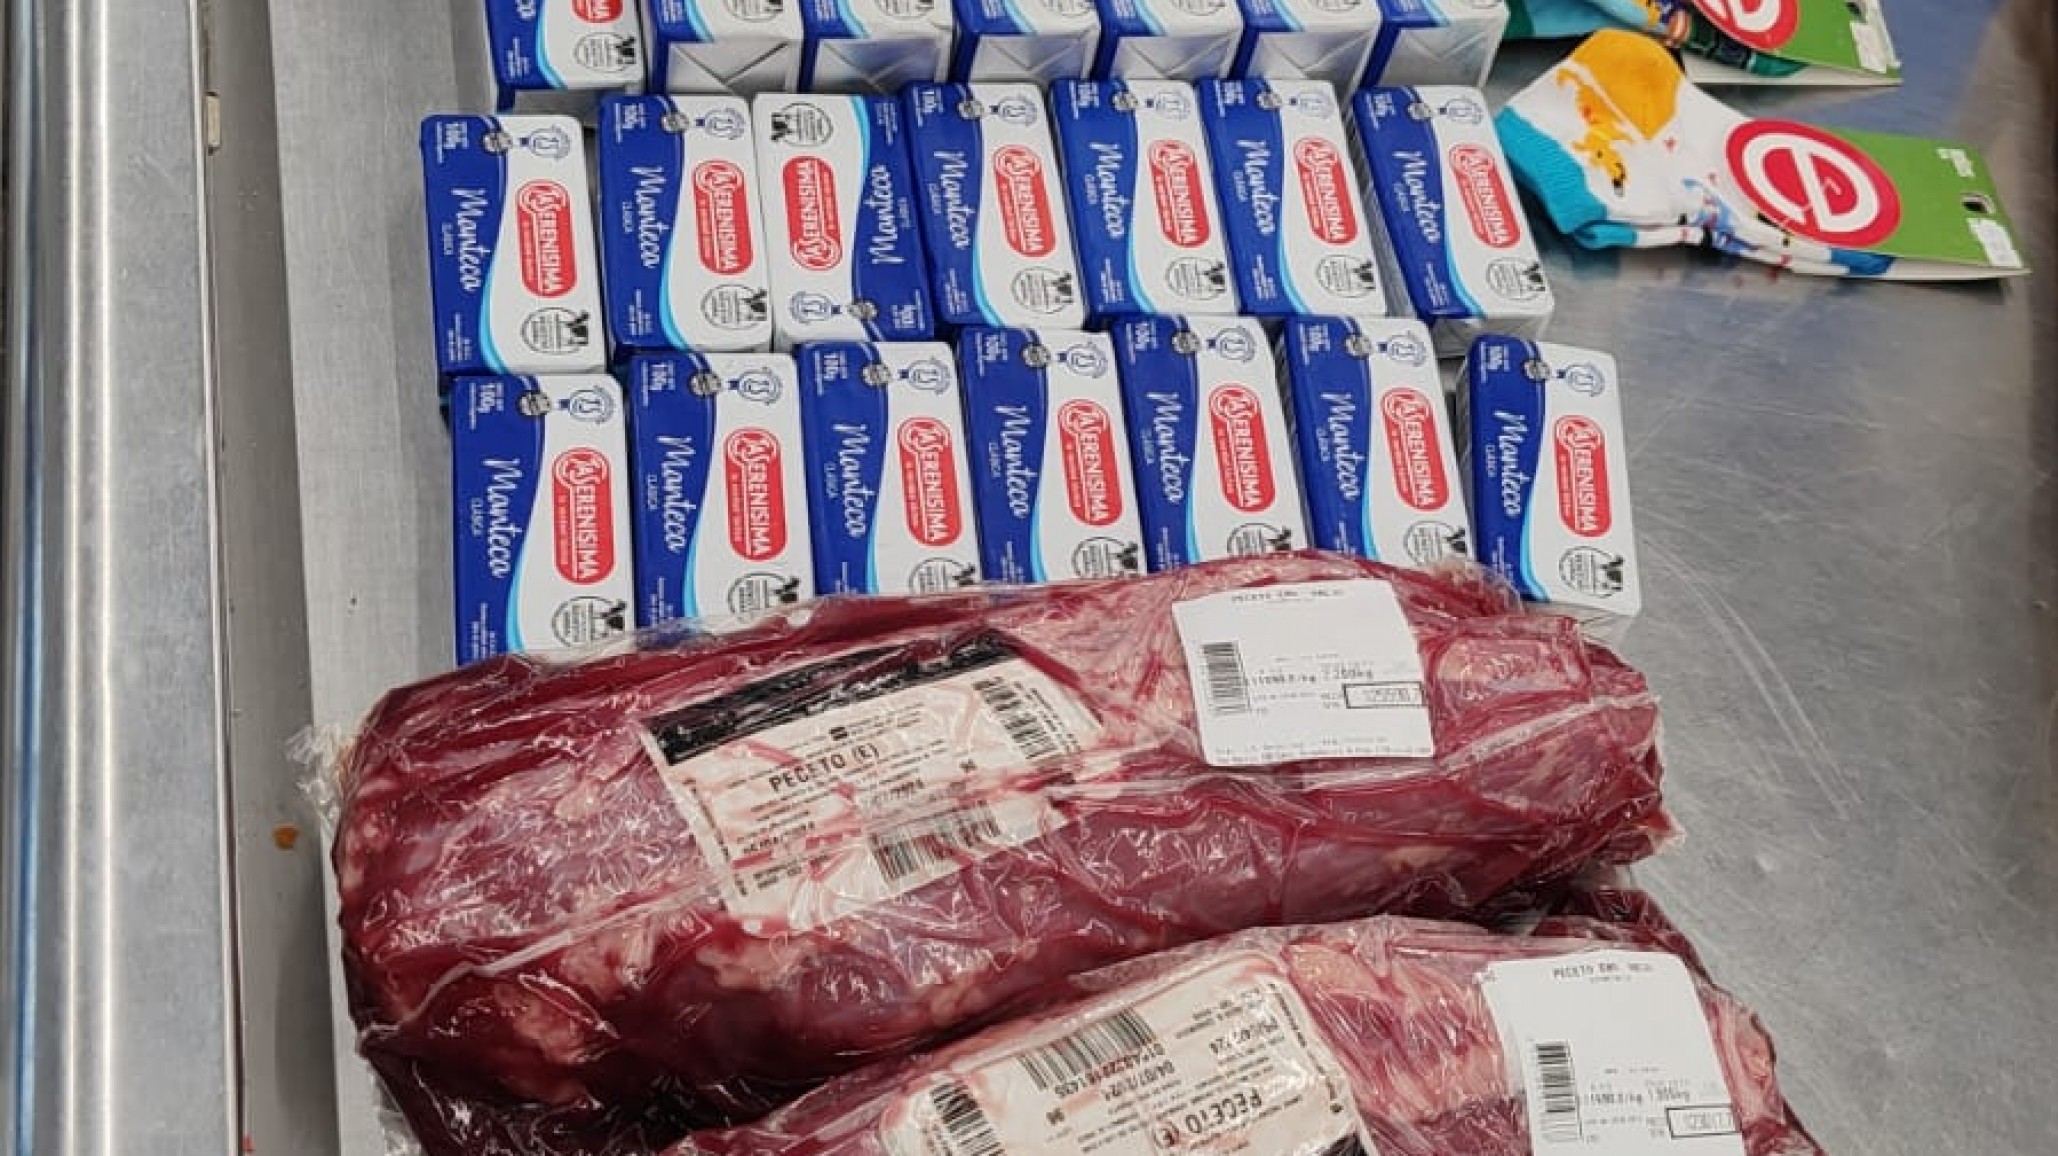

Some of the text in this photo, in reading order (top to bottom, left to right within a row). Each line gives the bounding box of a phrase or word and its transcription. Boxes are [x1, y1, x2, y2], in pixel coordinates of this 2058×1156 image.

[632, 167, 665, 268] Manteca
[862, 163, 904, 264] Manteca
[934, 151, 976, 249] Manteca
[1090, 142, 1131, 240] Manteca
[1237, 140, 1280, 236] Manteca
[1392, 151, 1440, 243] Manteca
[452, 189, 490, 295] Manteca
[657, 436, 695, 552] Manteca
[833, 424, 873, 538] Manteca
[995, 406, 1034, 517] Manteca
[1147, 392, 1187, 502] Manteca
[1322, 393, 1366, 499] Manteca
[1494, 411, 1532, 518] Manteca
[483, 459, 523, 579] Manteca
[769, 752, 847, 793] PECETO
